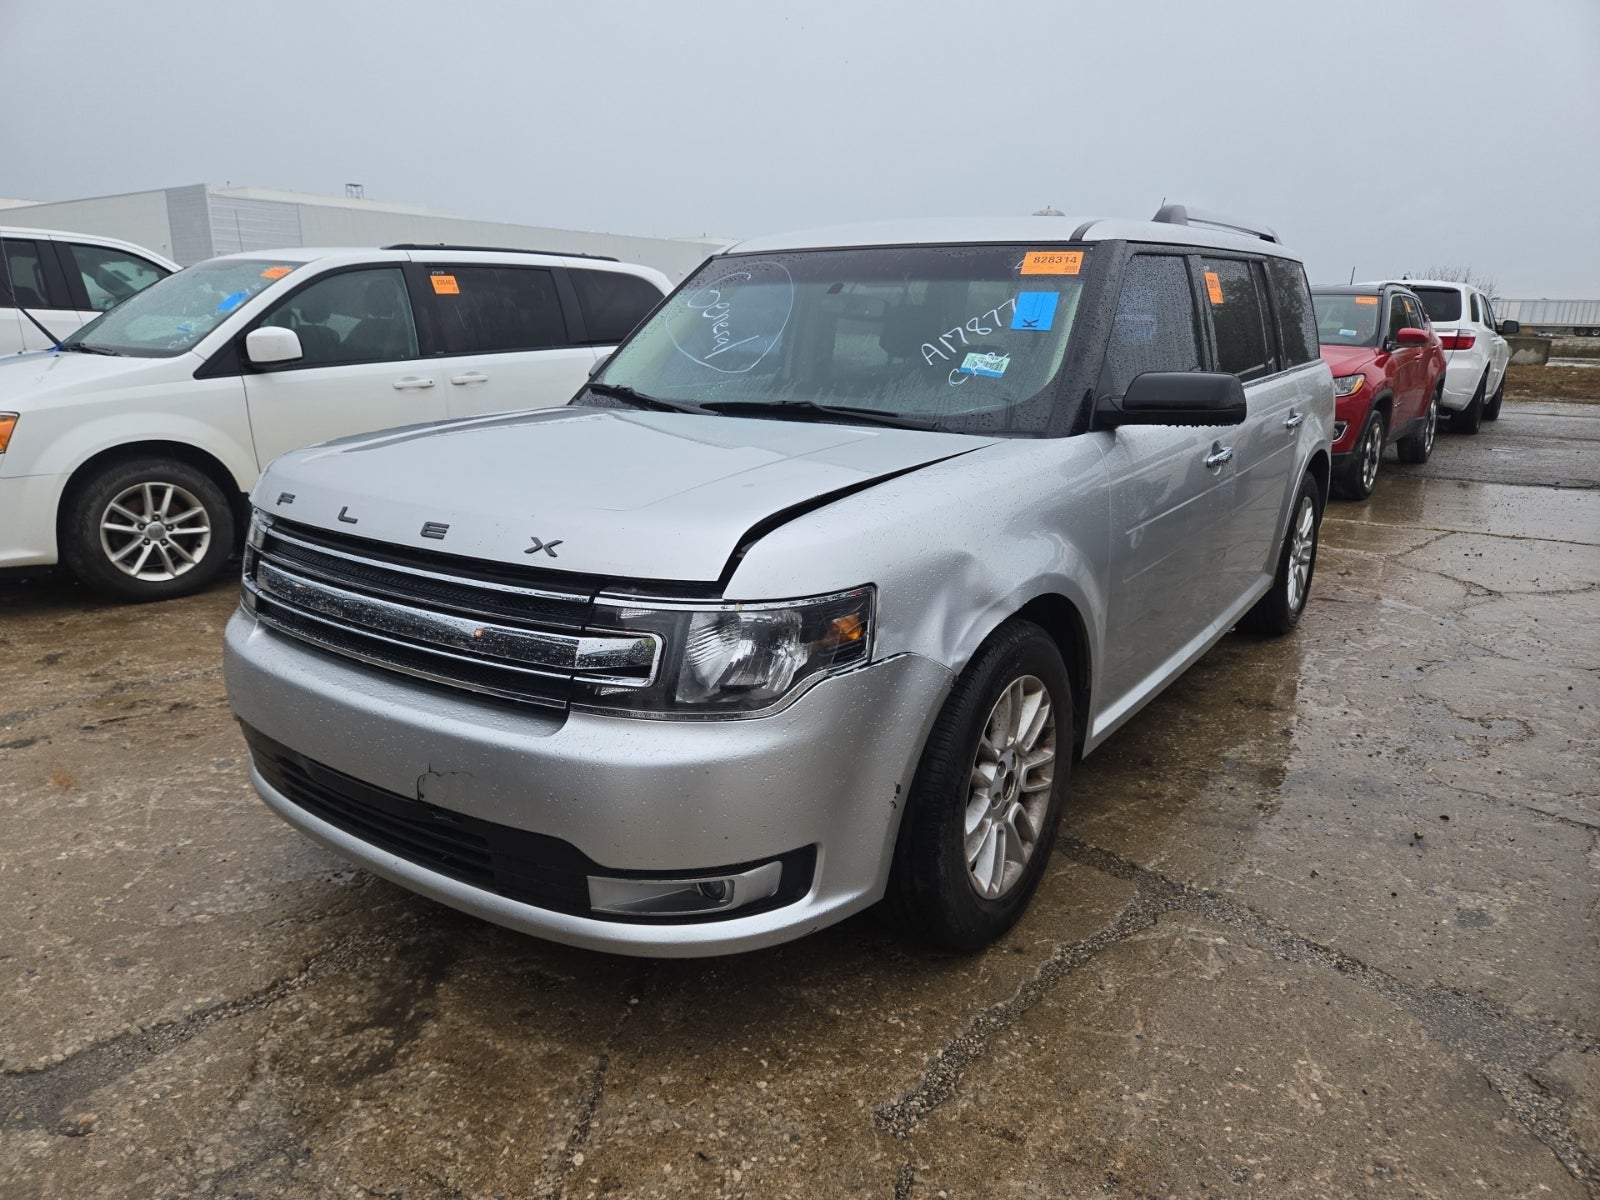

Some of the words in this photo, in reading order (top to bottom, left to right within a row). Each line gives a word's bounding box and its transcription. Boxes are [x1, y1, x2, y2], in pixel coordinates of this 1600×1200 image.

[1033, 256, 1077, 264] 828314
[1022, 319, 1040, 328] K
[276, 492, 564, 558] FLEX
